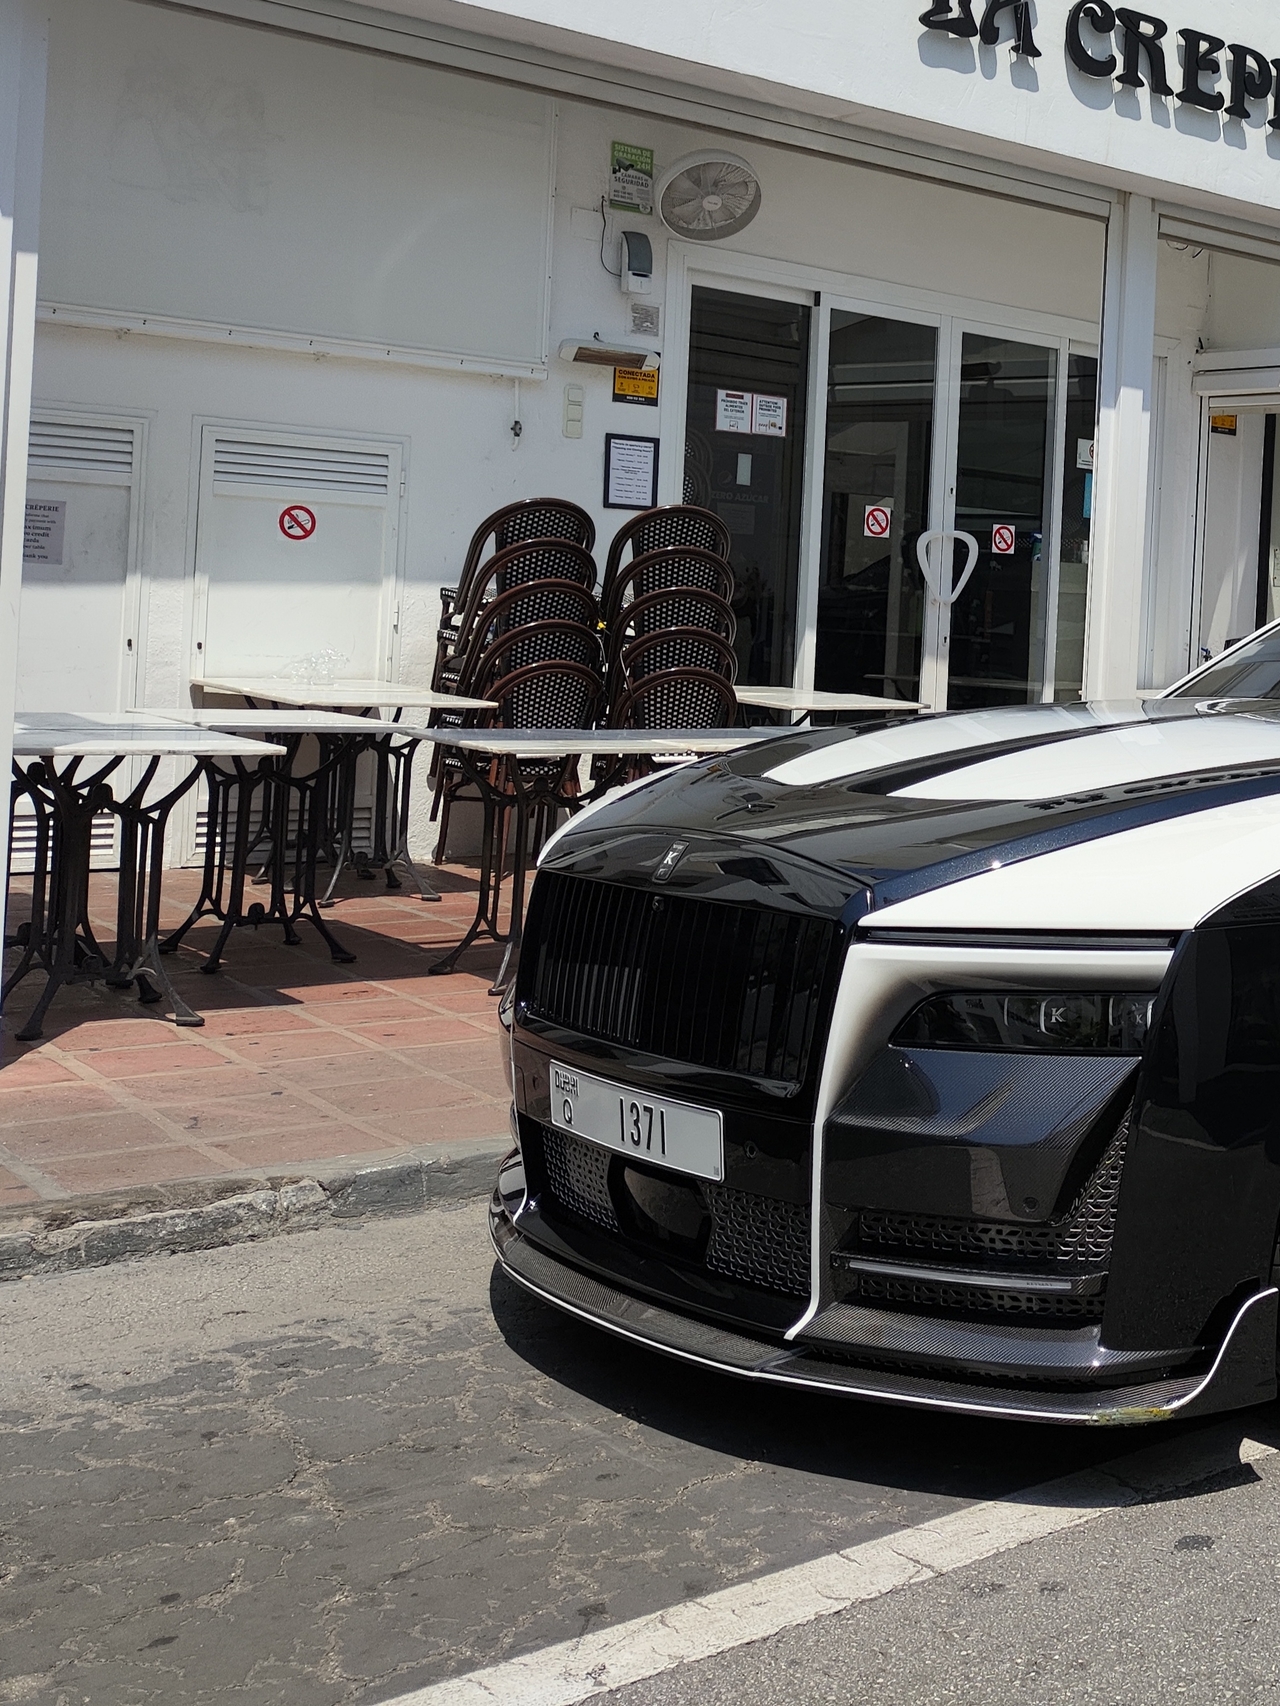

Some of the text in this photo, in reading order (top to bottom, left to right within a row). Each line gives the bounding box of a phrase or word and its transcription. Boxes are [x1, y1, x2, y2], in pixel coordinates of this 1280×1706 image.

[614, 144, 651, 157] SISTEMA DE
[636, 161, 651, 170] 24H
[614, 176, 649, 188] SEGURIDAD
[618, 369, 655, 379] CONECTADA
[663, 851, 680, 865] K
[1050, 1007, 1067, 1023] K
[563, 1097, 574, 1126] Q
[619, 1096, 667, 1157] 1371
